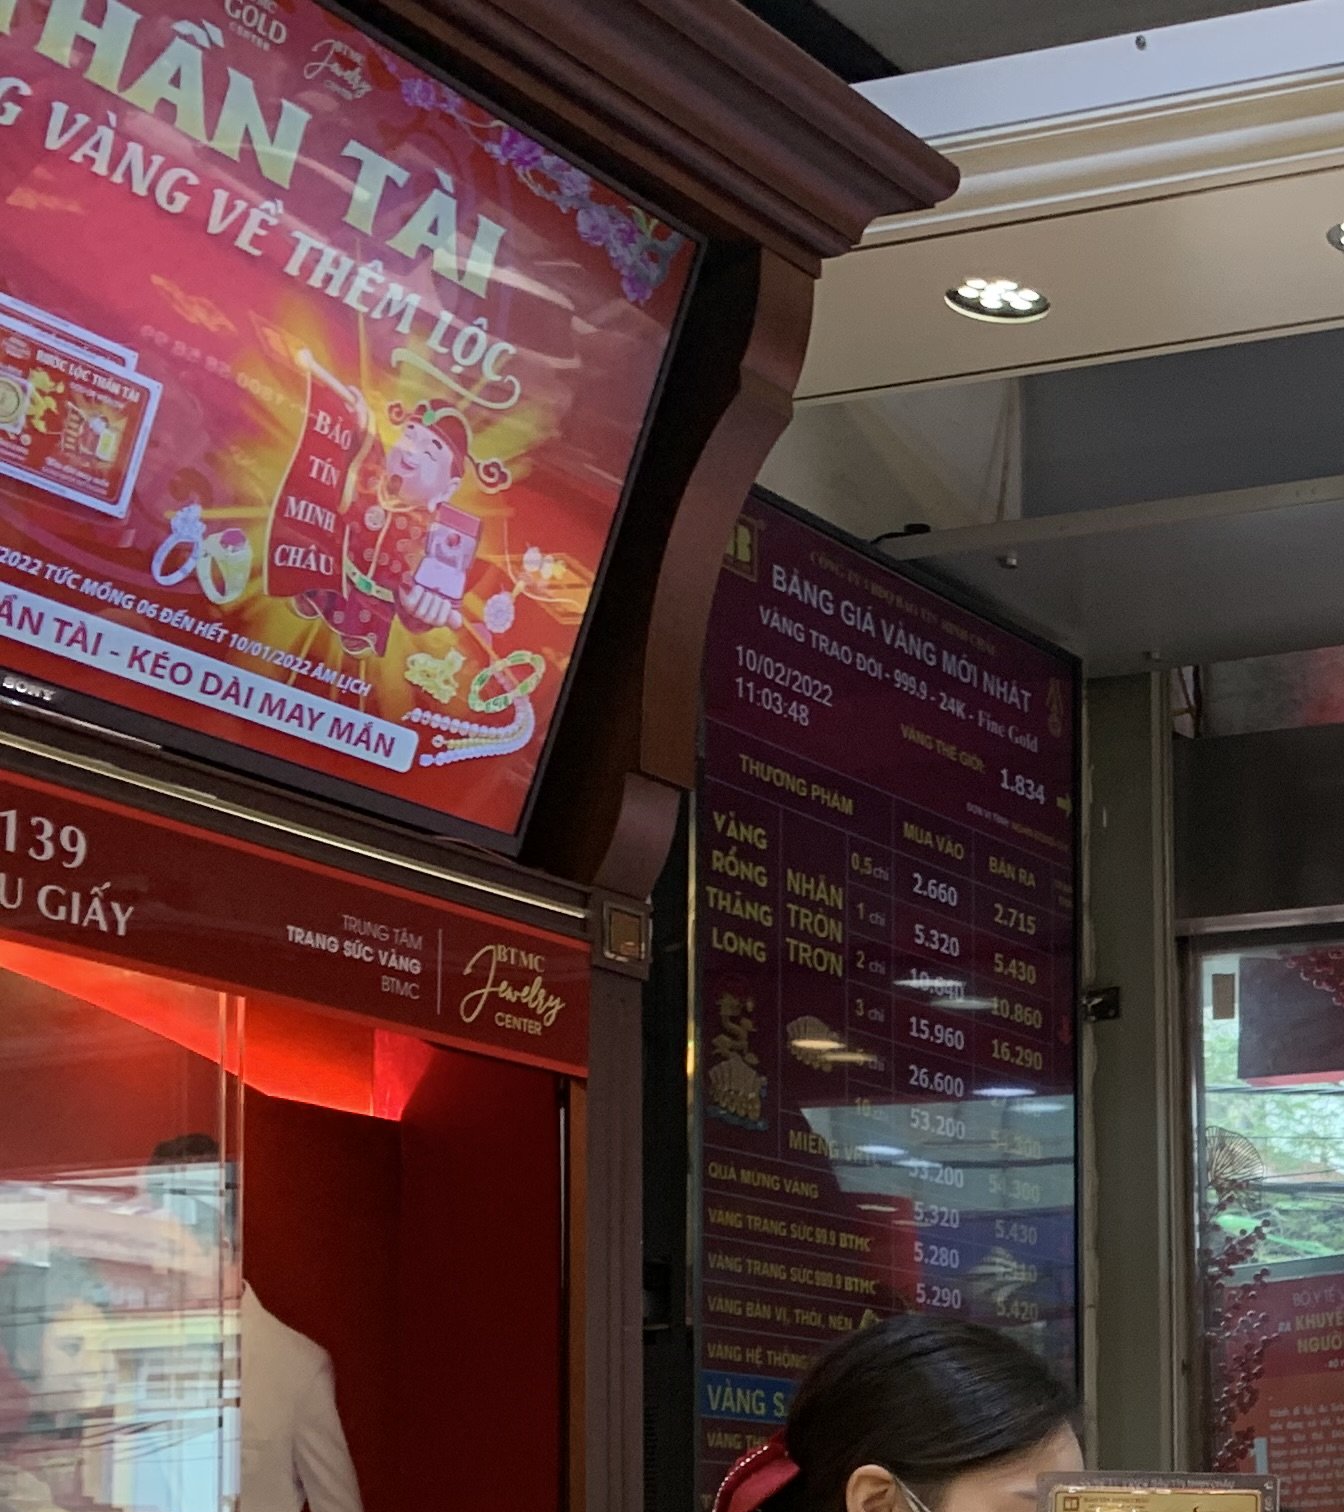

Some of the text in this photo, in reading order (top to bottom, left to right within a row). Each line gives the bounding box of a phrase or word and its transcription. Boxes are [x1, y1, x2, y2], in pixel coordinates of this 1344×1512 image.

[0, 0, 506, 298] HẦN TÀI
[44, 101, 517, 384] VÀNG VỀ THÊM LỘC
[315, 410, 353, 452] BẢO
[308, 452, 340, 490] TÍN
[284, 494, 336, 535] MINH
[273, 537, 334, 577] CHÂU
[44, 563, 81, 590] TỨC
[136, 599, 160, 618] 06
[157, 606, 196, 632] ĐẾN
[194, 619, 230, 644] HẾT
[229, 633, 311, 676] 10/01/2022
[310, 664, 338, 686] ÂM
[336, 674, 373, 697] LỊCH
[772, 563, 834, 616] BẢNG
[840, 600, 876, 637] GIÁ
[881, 618, 937, 667] VÀNG
[942, 654, 978, 688] MỚI
[52, 617, 396, 758] TÀI KÉO DÀI MAY MẮN
[736, 645, 834, 708] 10/02/2022
[759, 605, 805, 643] VÀNG
[809, 629, 852, 665] TRAO
[894, 668, 928, 701] 999.9
[940, 693, 966, 721] 24K
[978, 709, 1006, 738] Fine
[1008, 723, 1038, 753] Gold
[736, 676, 810, 727] 11:03:48
[739, 752, 808, 798] THƯƠNG
[1000, 767, 1046, 806] 1.834
[0, 809, 87, 869] 139
[713, 809, 768, 851] VÀNG
[903, 821, 965, 860] MUA VÀO
[912, 872, 958, 907] 2.660
[989, 855, 1036, 888] BÁN RA
[37, 881, 134, 936] GIẤY
[706, 886, 774, 928] THĂNG
[786, 903, 843, 944] TRÒN
[857, 902, 866, 920] 1
[993, 903, 1037, 936] 2.715
[287, 925, 421, 975] TRANG SỨC VÀNG
[342, 914, 423, 950] TRUNG TÂM
[712, 926, 767, 963] LONG
[914, 923, 960, 958] 5.320
[497, 944, 545, 973] BTMC
[786, 937, 843, 978] TRƠN
[856, 951, 865, 969] 2
[993, 952, 1037, 985] 5.430
[381, 975, 420, 1000] BTMC
[460, 944, 565, 1026] Jewelry
[495, 1011, 542, 1036] CENTER
[855, 999, 865, 1017] 3
[991, 996, 1043, 1029] 10.860
[909, 1016, 965, 1051] 15.960
[991, 1038, 1043, 1071] 16.290
[908, 1064, 965, 1098] 26.600
[910, 1108, 965, 1140] 53.200
[708, 1159, 819, 1199] QUÀ MỪNG VÀNG
[708, 1207, 743, 1229] VÀNG
[746, 1215, 787, 1237] TRANG
[790, 1220, 815, 1241] SỨC
[839, 1232, 873, 1252] BTMC
[913, 1201, 960, 1229] 5.320
[995, 1219, 1038, 1245] 5.430
[708, 1251, 743, 1273] VÀNG
[746, 1258, 787, 1280] TRANG
[790, 1264, 815, 1285] SỨC
[913, 1242, 960, 1269] 5.280
[708, 1295, 742, 1316] VÀNG
[916, 1283, 962, 1310] 5.290
[708, 1342, 742, 1362] VÀNG
[707, 1378, 765, 1415] VÀNG
